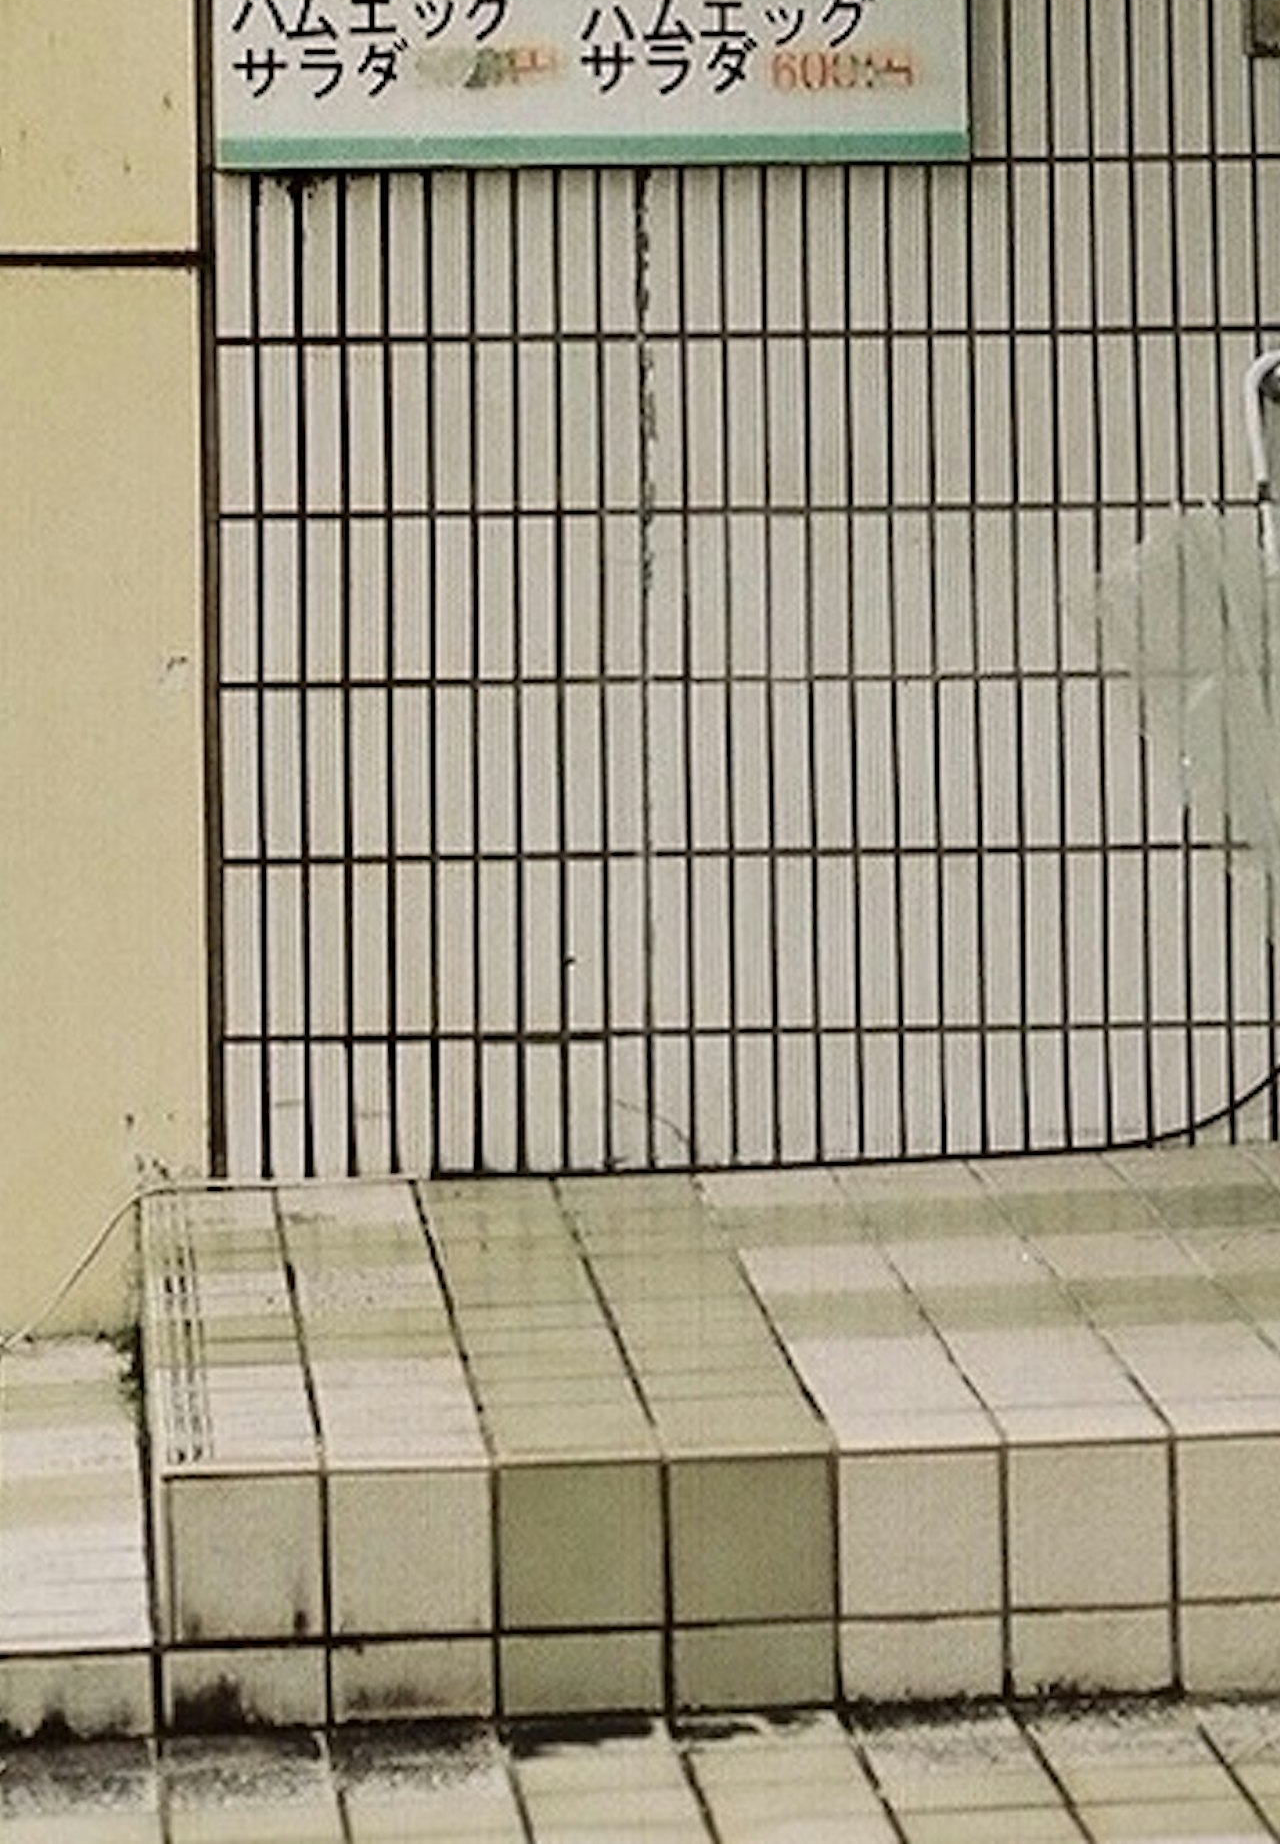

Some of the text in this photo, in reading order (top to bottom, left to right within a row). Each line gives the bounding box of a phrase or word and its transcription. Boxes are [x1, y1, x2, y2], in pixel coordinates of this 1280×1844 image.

[232, 38, 409, 99] サラダ
[581, 37, 758, 96] サラダ
